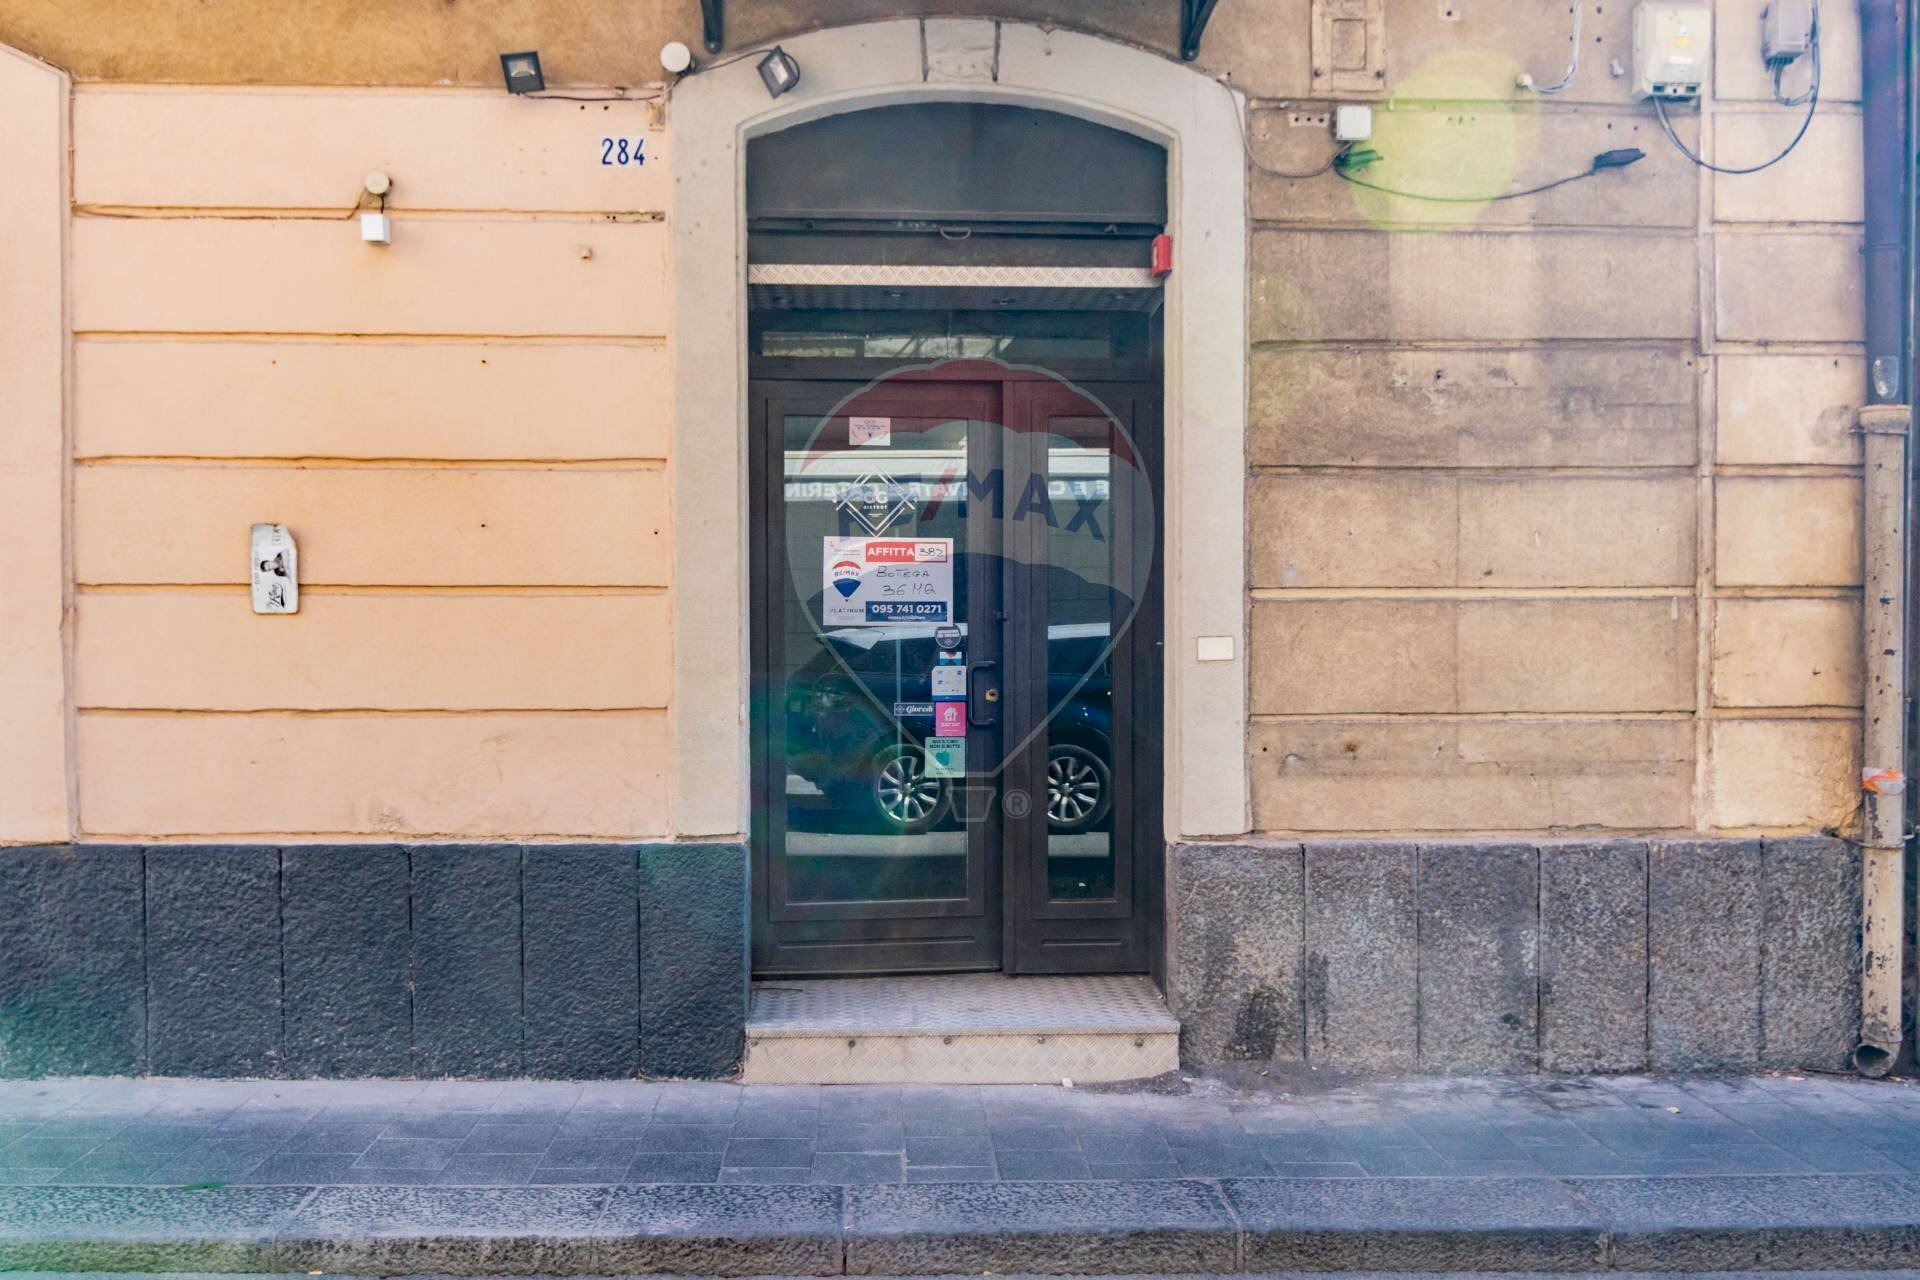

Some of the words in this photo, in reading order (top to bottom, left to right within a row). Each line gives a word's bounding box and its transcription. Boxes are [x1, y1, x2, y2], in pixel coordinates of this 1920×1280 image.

[601, 137, 645, 165] 284
[867, 547, 915, 556] AFFITTA
[882, 584, 906, 596] 36
[871, 604, 893, 613] 095
[896, 604, 914, 613] 741
[916, 604, 942, 613] 0271
